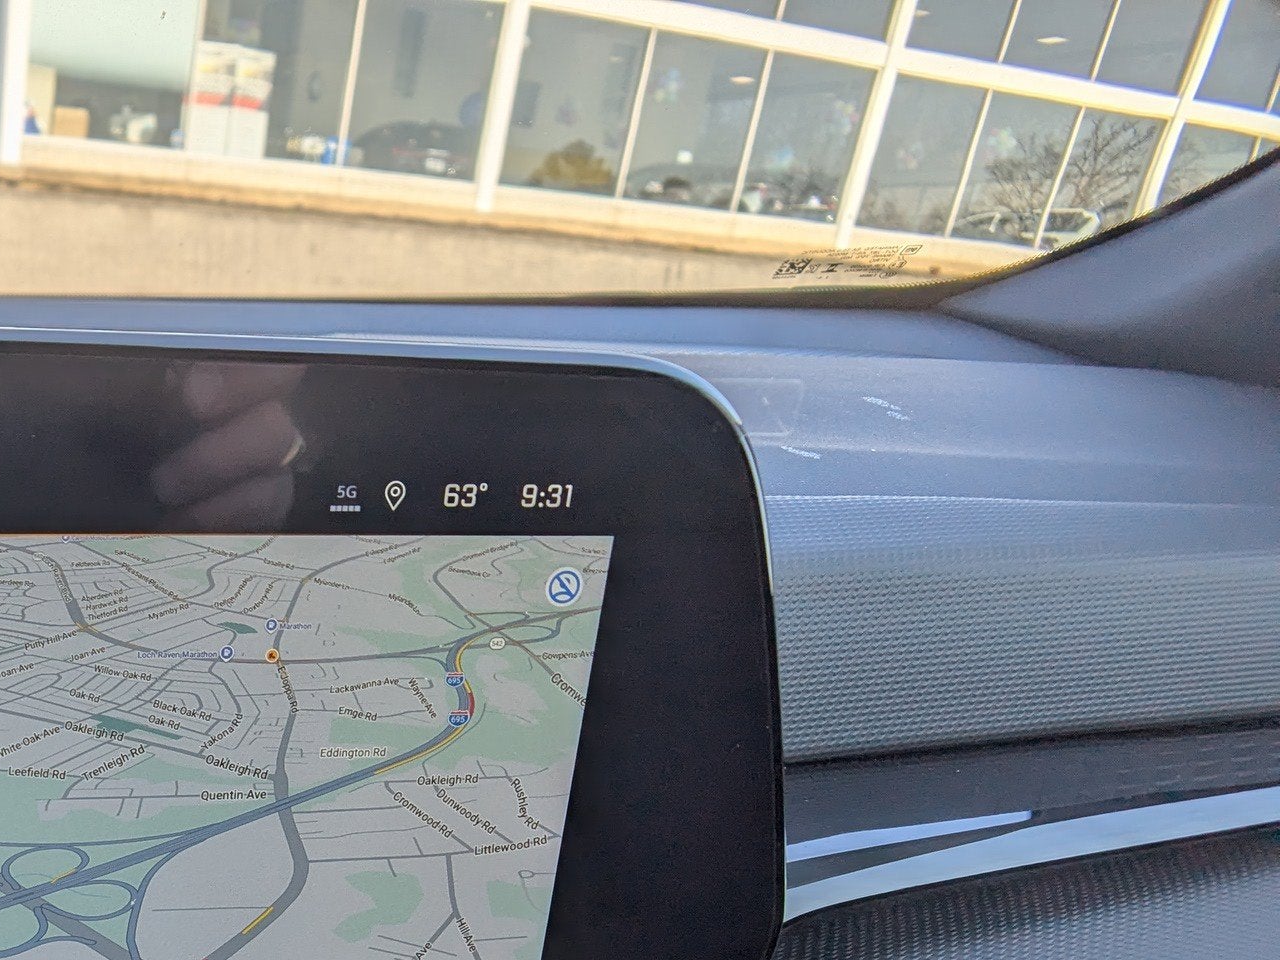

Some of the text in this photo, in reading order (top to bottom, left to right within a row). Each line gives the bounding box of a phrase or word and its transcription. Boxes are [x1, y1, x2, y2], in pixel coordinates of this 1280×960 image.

[336, 485, 357, 498] 5G
[521, 484, 573, 508] 9:31
[118, 595, 128, 603] Rd
[178, 603, 190, 611] Rd
[118, 605, 128, 613] Rd
[24, 629, 77, 651] Putty Hill Ave
[70, 646, 106, 662] Joan Ave
[158, 651, 180, 659] Raven
[182, 650, 218, 658] Marathon
[18, 662, 35, 673] Ave
[94, 664, 152, 682] Willow Oak Rd
[279, 673, 295, 702] Joppa
[289, 700, 299, 714] Rd
[329, 677, 399, 694] Lackawanna Ave
[69, 688, 101, 703] Oak Rd
[408, 677, 437, 719] Wayne Ave
[152, 699, 212, 722] Black Oak Rd
[338, 706, 378, 721] Emge Rd
[450, 715, 465, 724] 695
[64, 720, 124, 742] Oakleigh Rd
[148, 714, 181, 731] Oak Rd
[22, 733, 42, 747] Oak
[42, 725, 61, 739] Ave
[200, 712, 244, 752] Yakona Rd
[320, 747, 387, 759] Eddington Rd
[81, 743, 145, 783] Trenleigh Rd
[205, 754, 268, 780] Oakleigh Rd
[8, 766, 67, 780] Leefield Rd
[416, 773, 479, 786] Oakleigh Rd
[200, 789, 267, 802] Quentin Ave
[510, 777, 540, 830] Rushley Rd
[392, 791, 453, 838] Cromwood Rd
[436, 788, 496, 835] Dunwoody Rd
[474, 835, 548, 856] Littlewood Rd
[456, 917, 477, 952] Hill Ave
[415, 941, 433, 960] Ave
